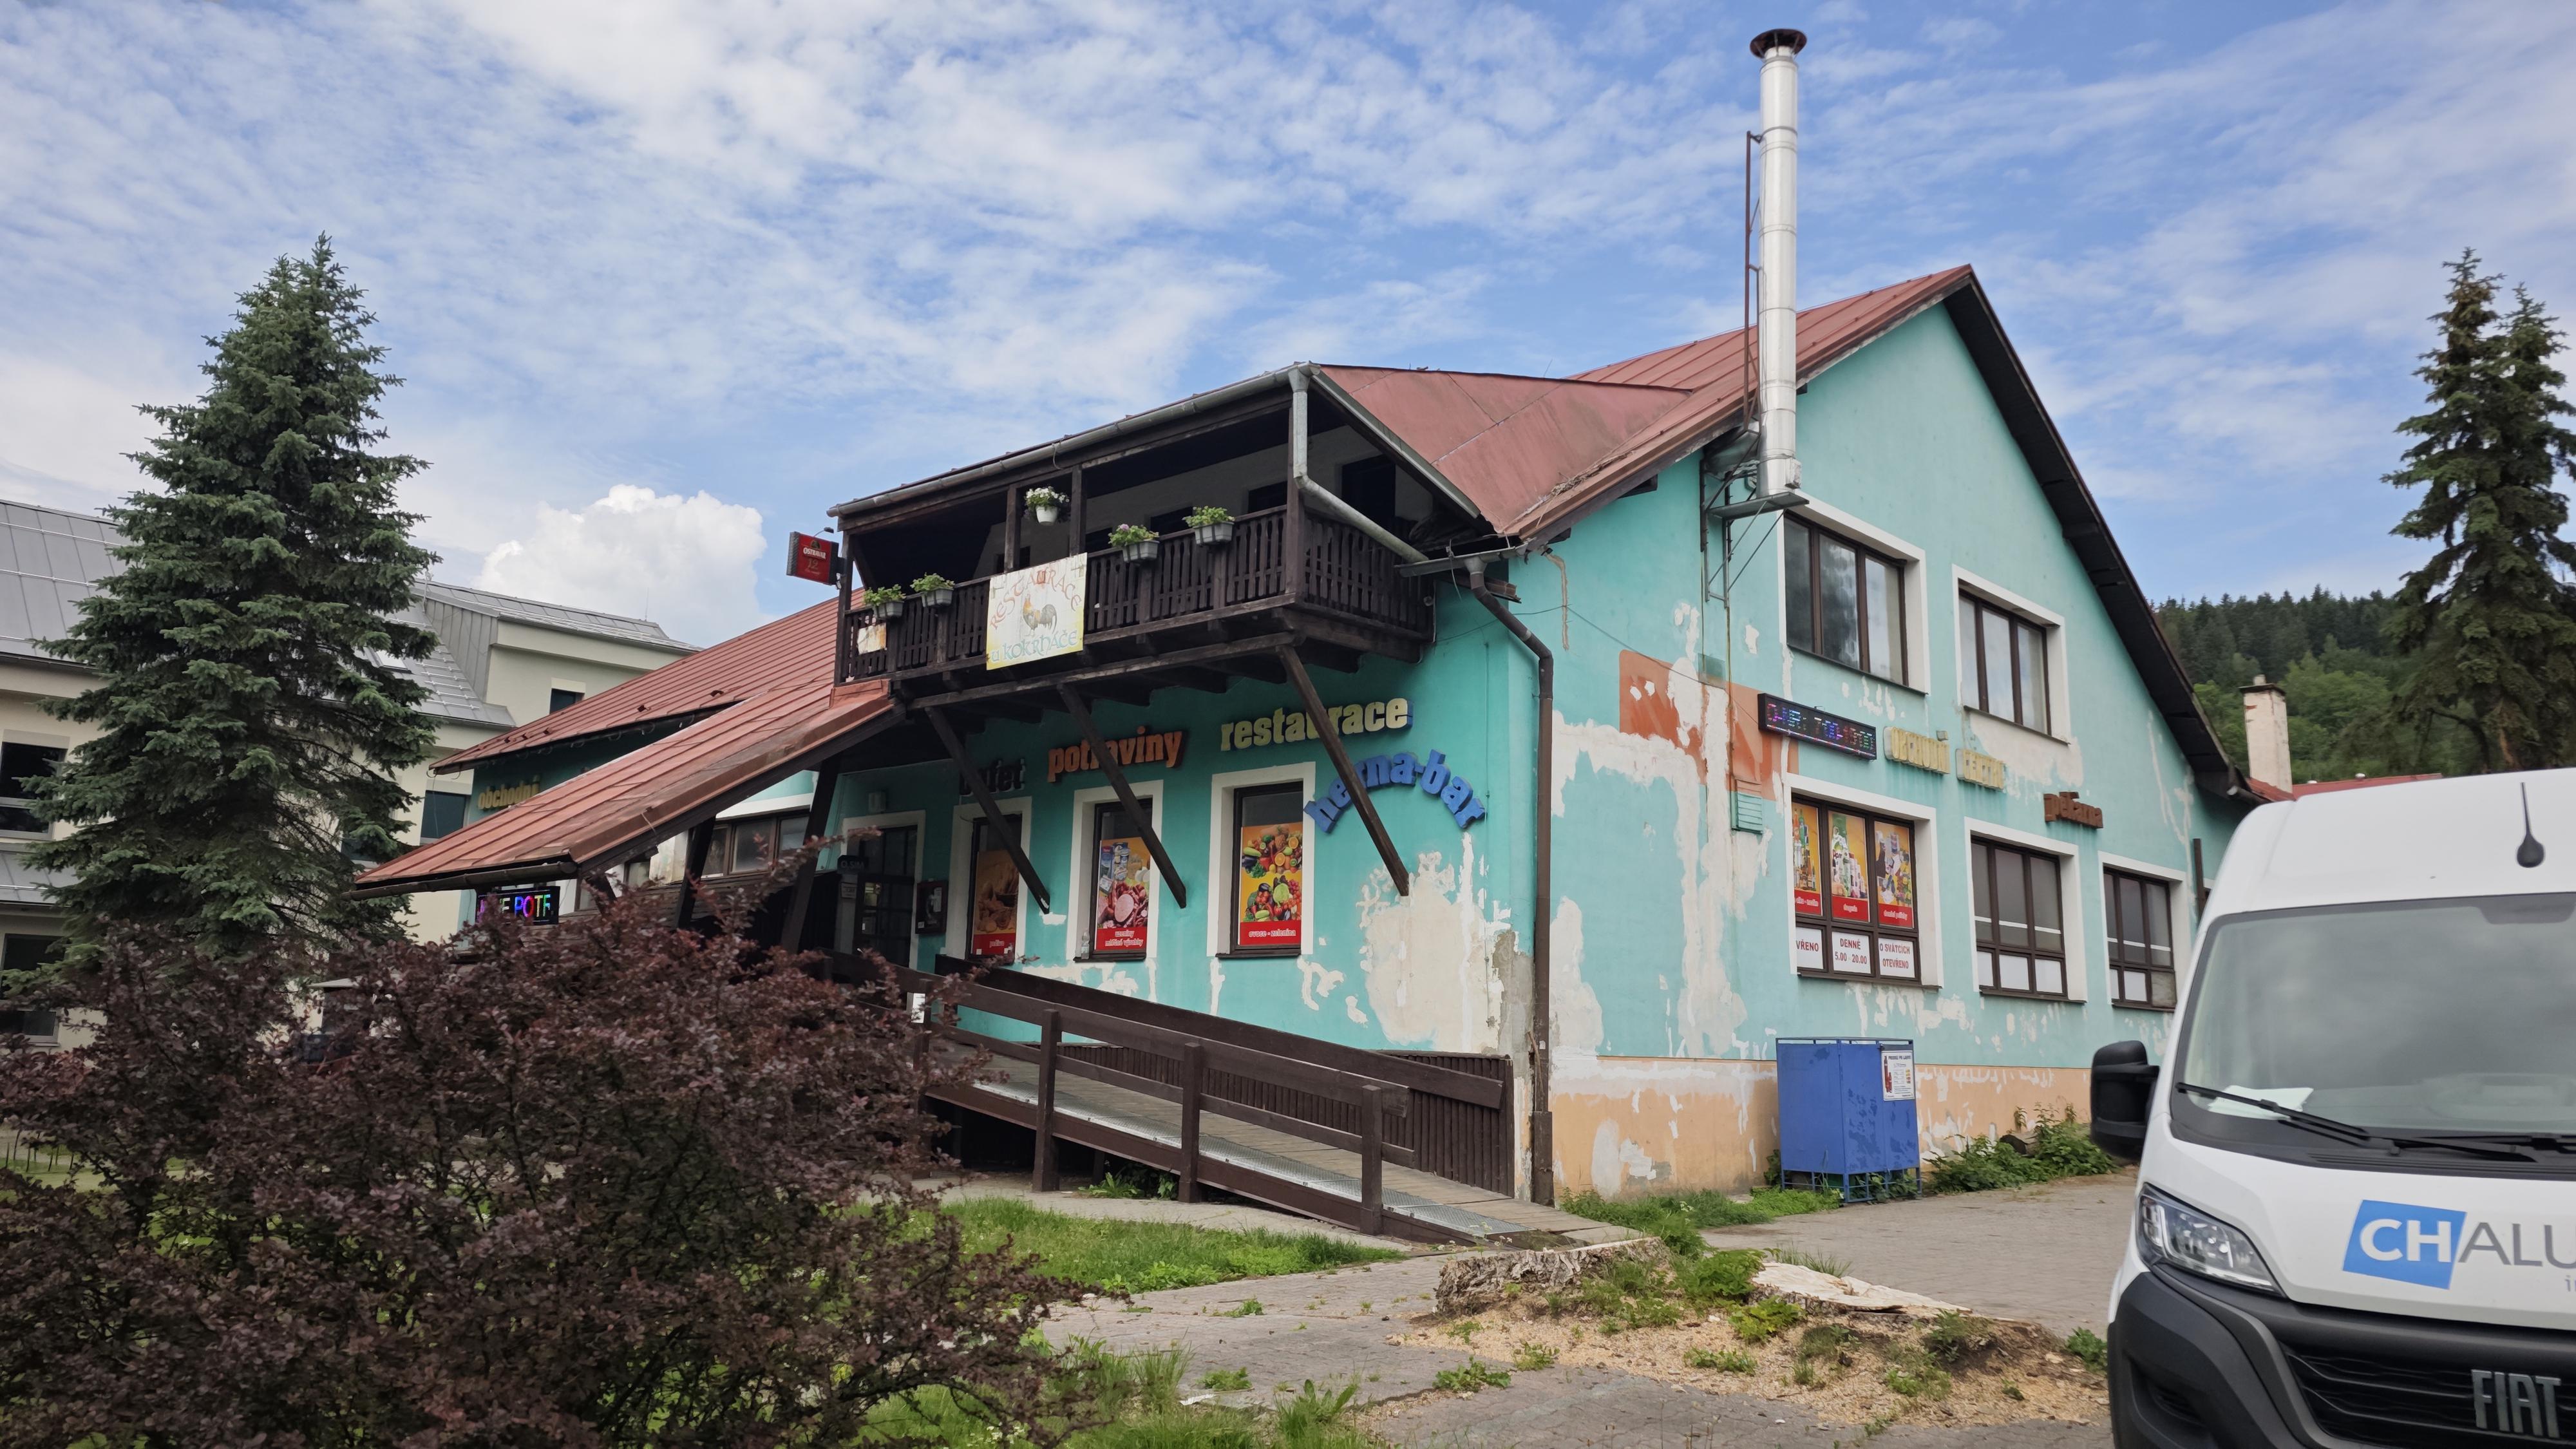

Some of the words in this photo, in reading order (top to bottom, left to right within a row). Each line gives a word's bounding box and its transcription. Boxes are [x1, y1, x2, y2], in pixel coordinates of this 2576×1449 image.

[1220, 697, 1413, 752] restaurace
[1835, 951, 1847, 961] 5.00
[1852, 954, 1867, 965] 20.00
[1882, 958, 1909, 969] OTEVŘENO
[2471, 1369, 2561, 1438] FIAT
